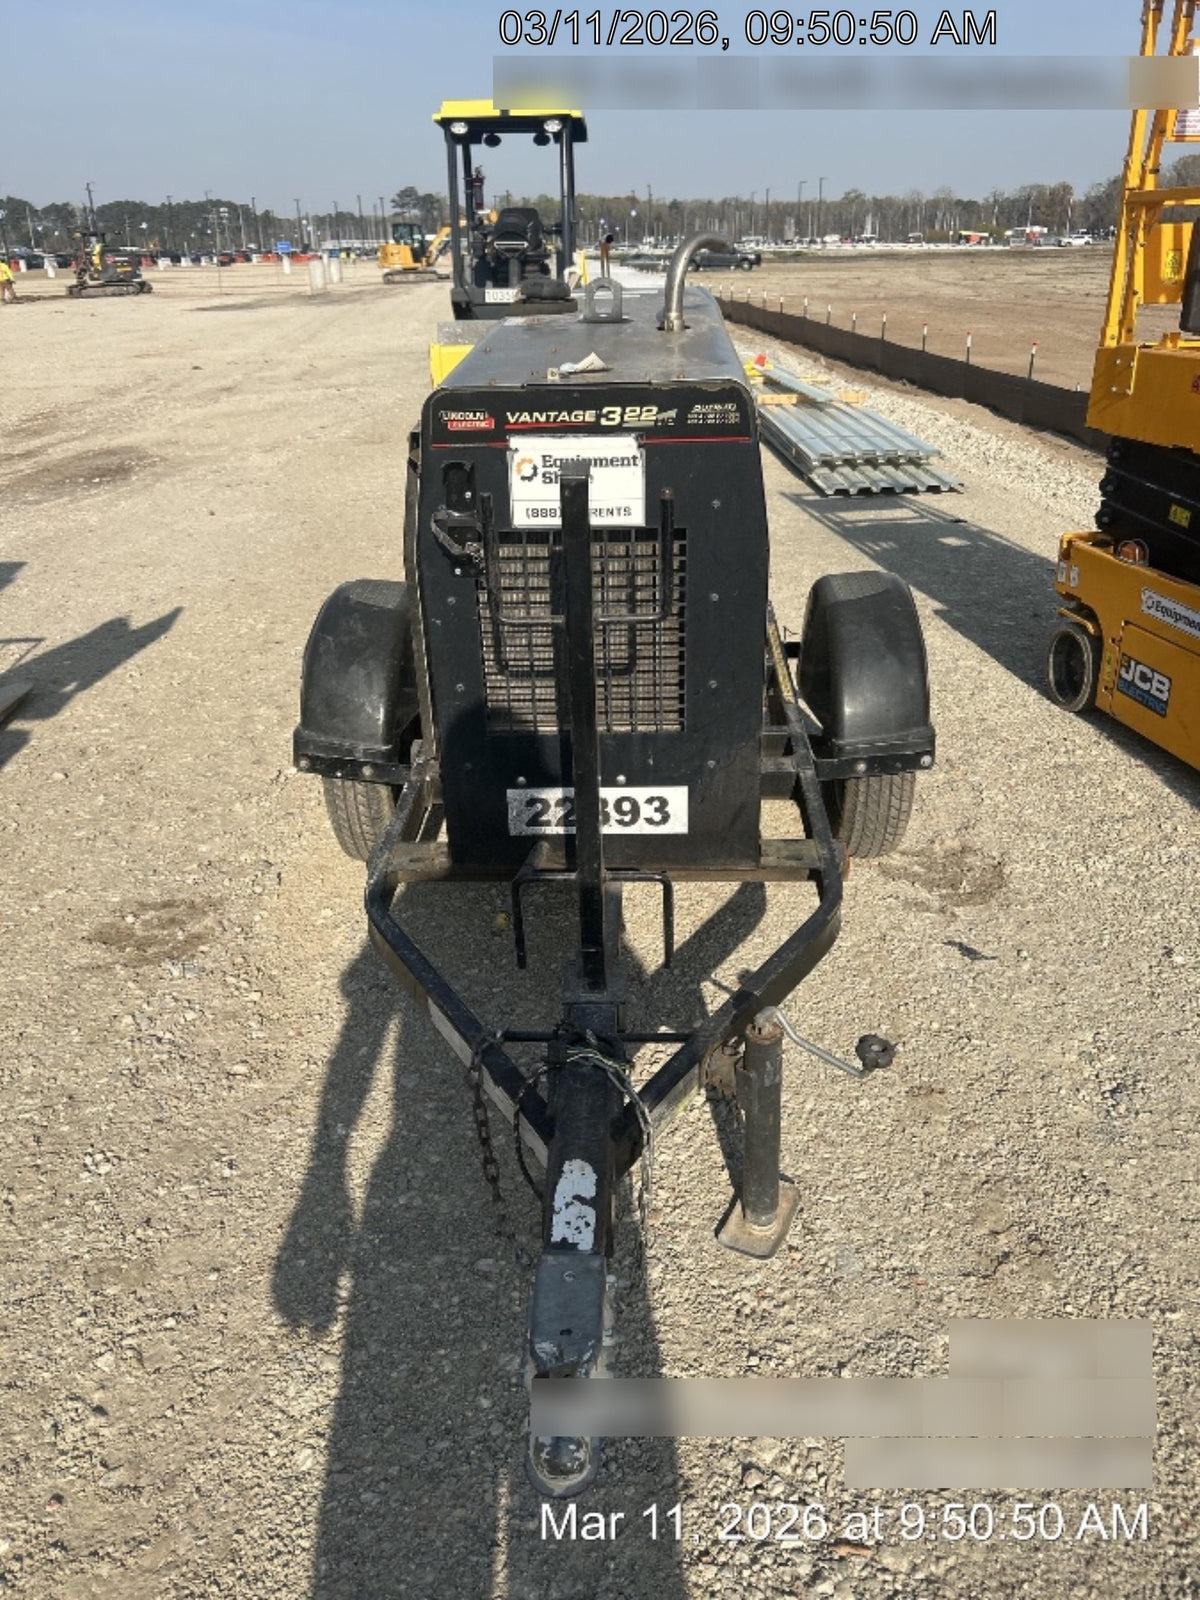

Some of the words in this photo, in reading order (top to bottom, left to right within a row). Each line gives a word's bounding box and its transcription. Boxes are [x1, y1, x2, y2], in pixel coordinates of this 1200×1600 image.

[506, 411, 596, 423] VANTAGE
[600, 406, 659, 426] 322
[1120, 659, 1170, 701] JCB
